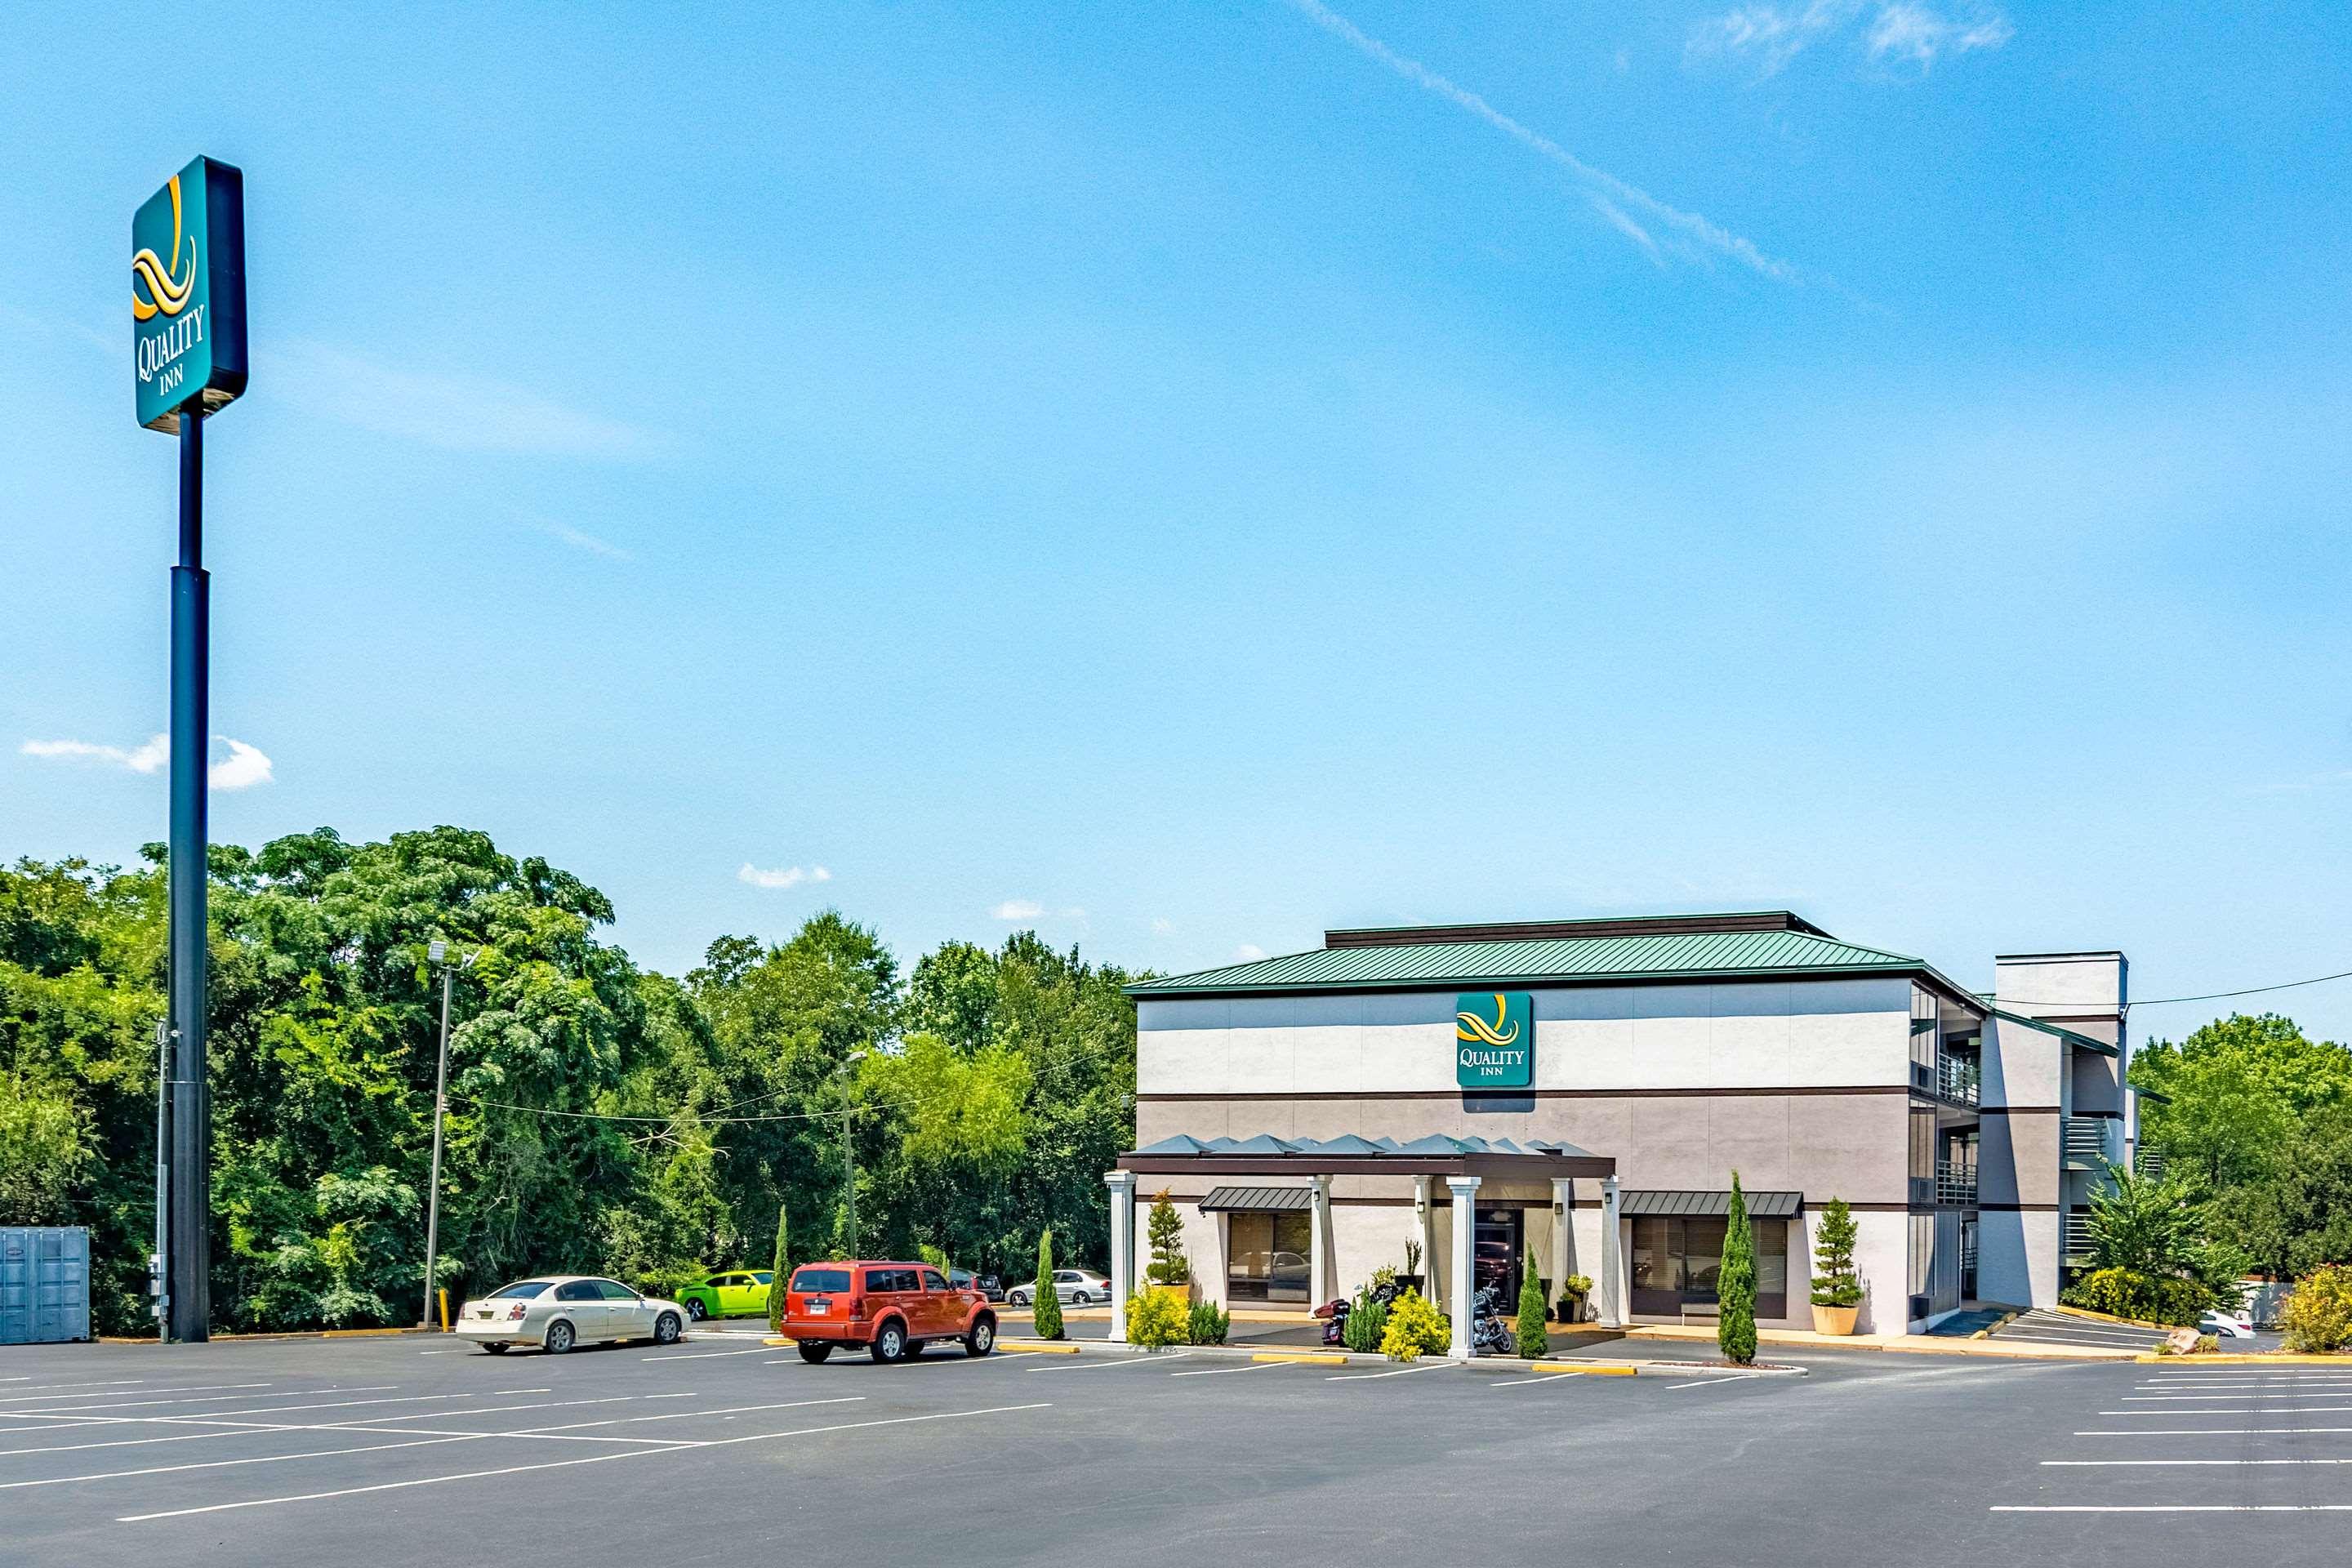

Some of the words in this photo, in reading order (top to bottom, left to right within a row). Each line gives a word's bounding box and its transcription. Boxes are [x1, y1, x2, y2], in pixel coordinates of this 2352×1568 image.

[138, 304, 204, 383] QUALITY
[159, 363, 183, 396] INN
[1459, 1048, 1525, 1067] QUALITY
[1481, 1067, 1503, 1076] INN
